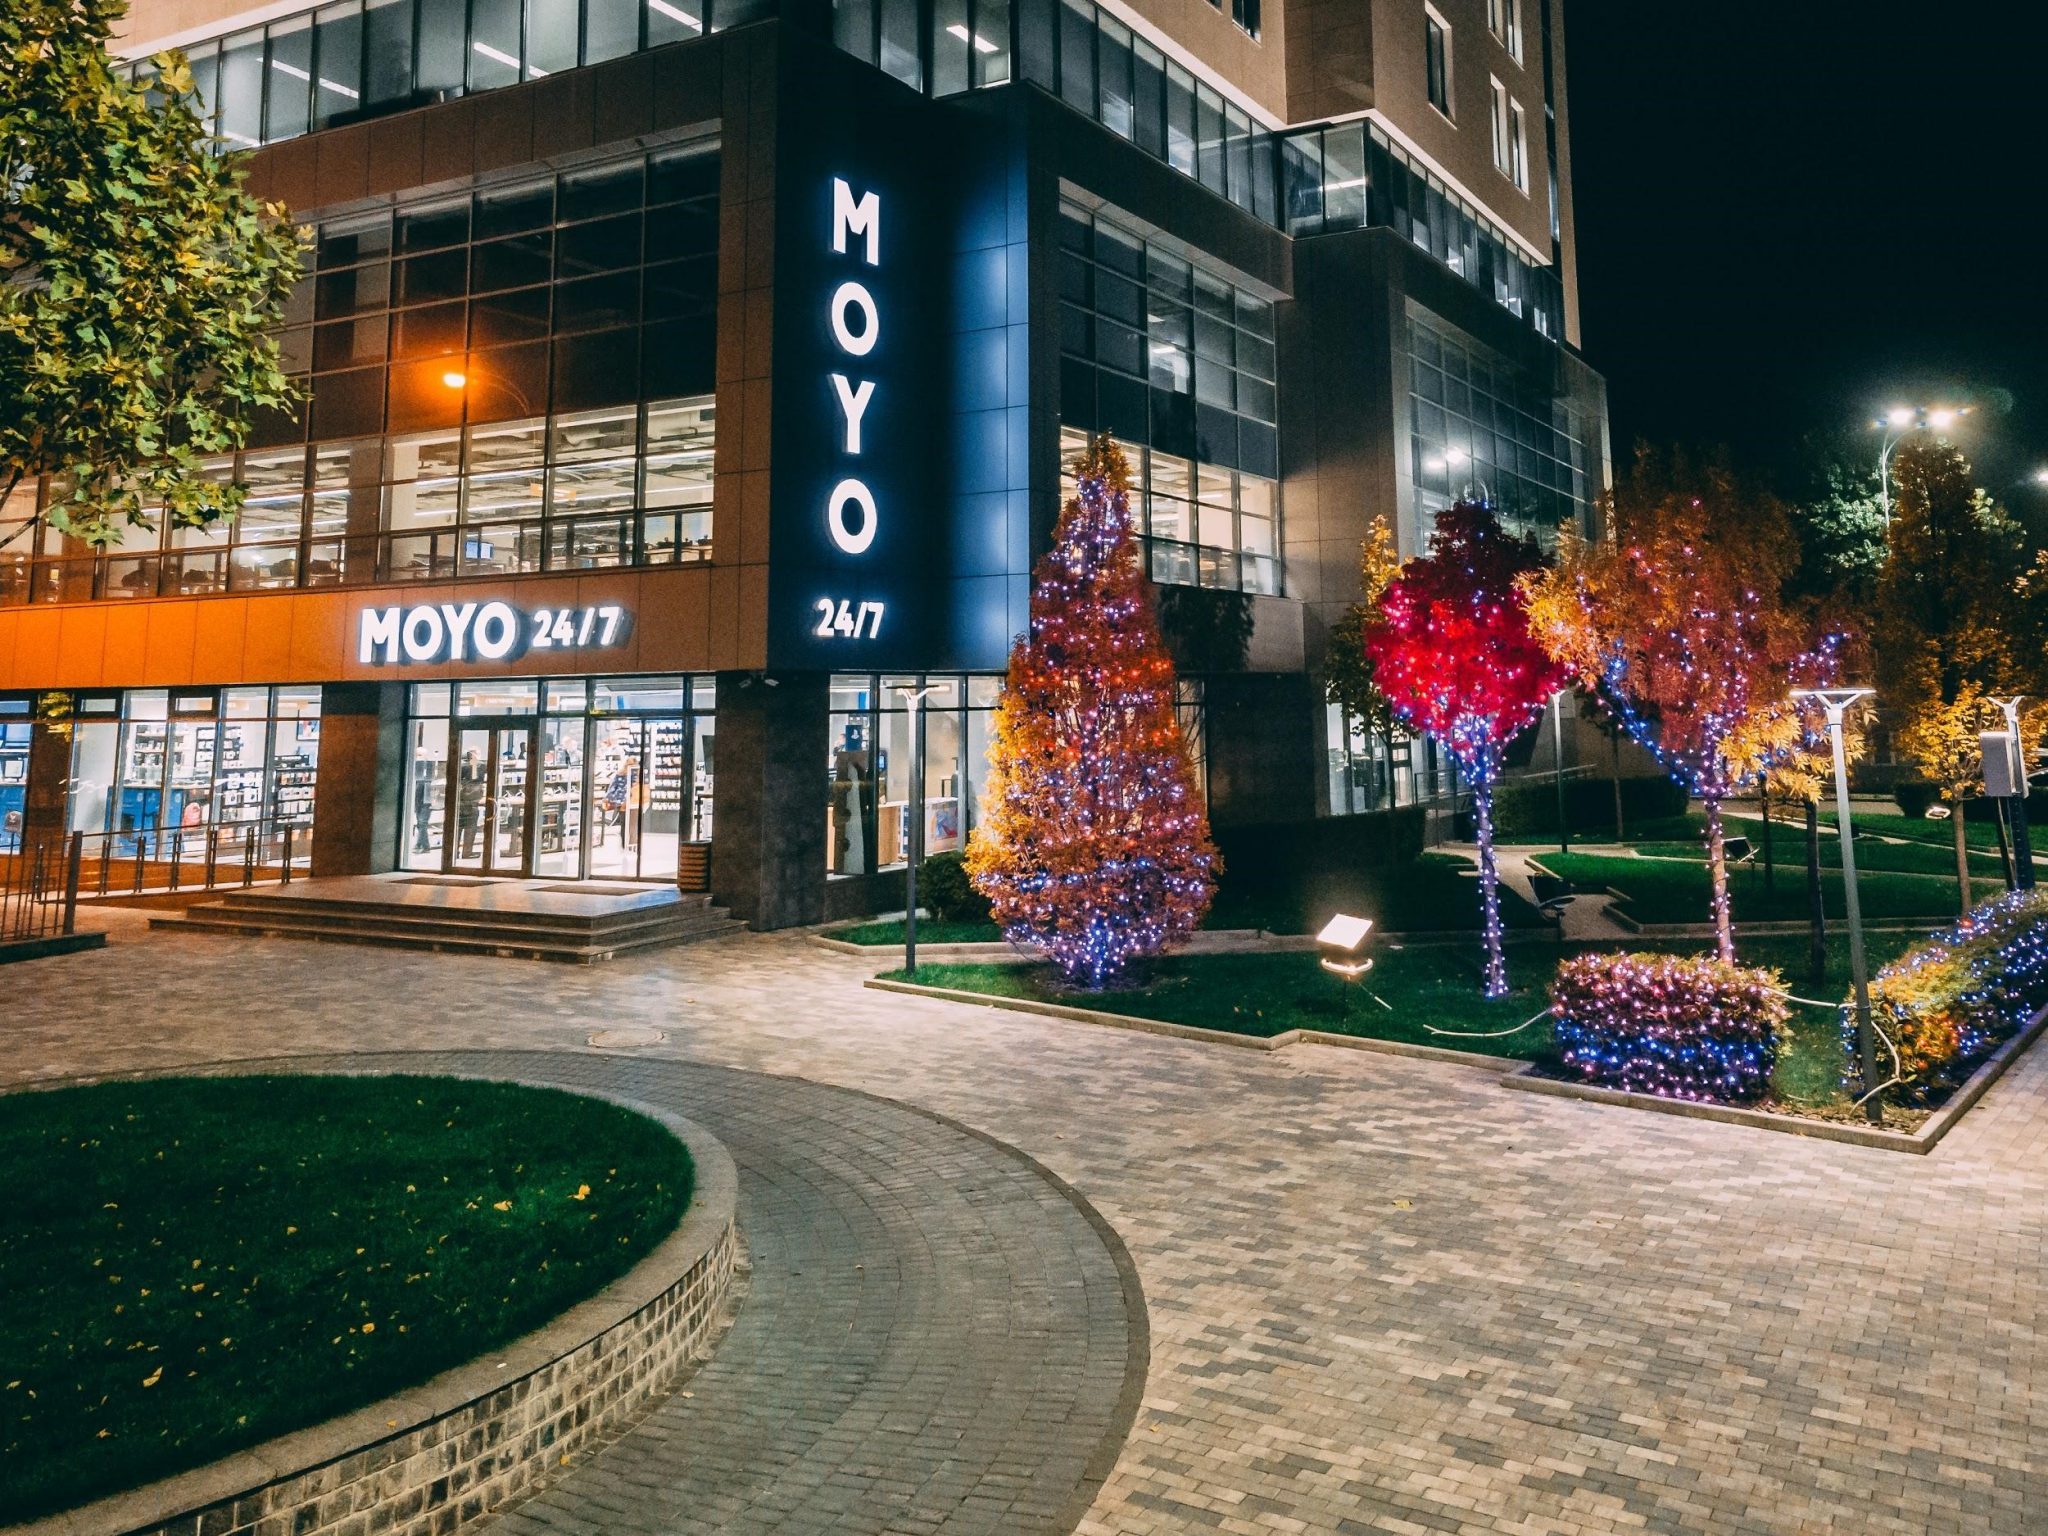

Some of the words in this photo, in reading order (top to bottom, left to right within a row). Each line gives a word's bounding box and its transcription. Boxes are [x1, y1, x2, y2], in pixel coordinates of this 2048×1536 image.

[828, 177, 880, 555] MOYO
[359, 601, 516, 663] MOYO
[530, 605, 622, 648] 24/7
[815, 597, 885, 639] 24/7
